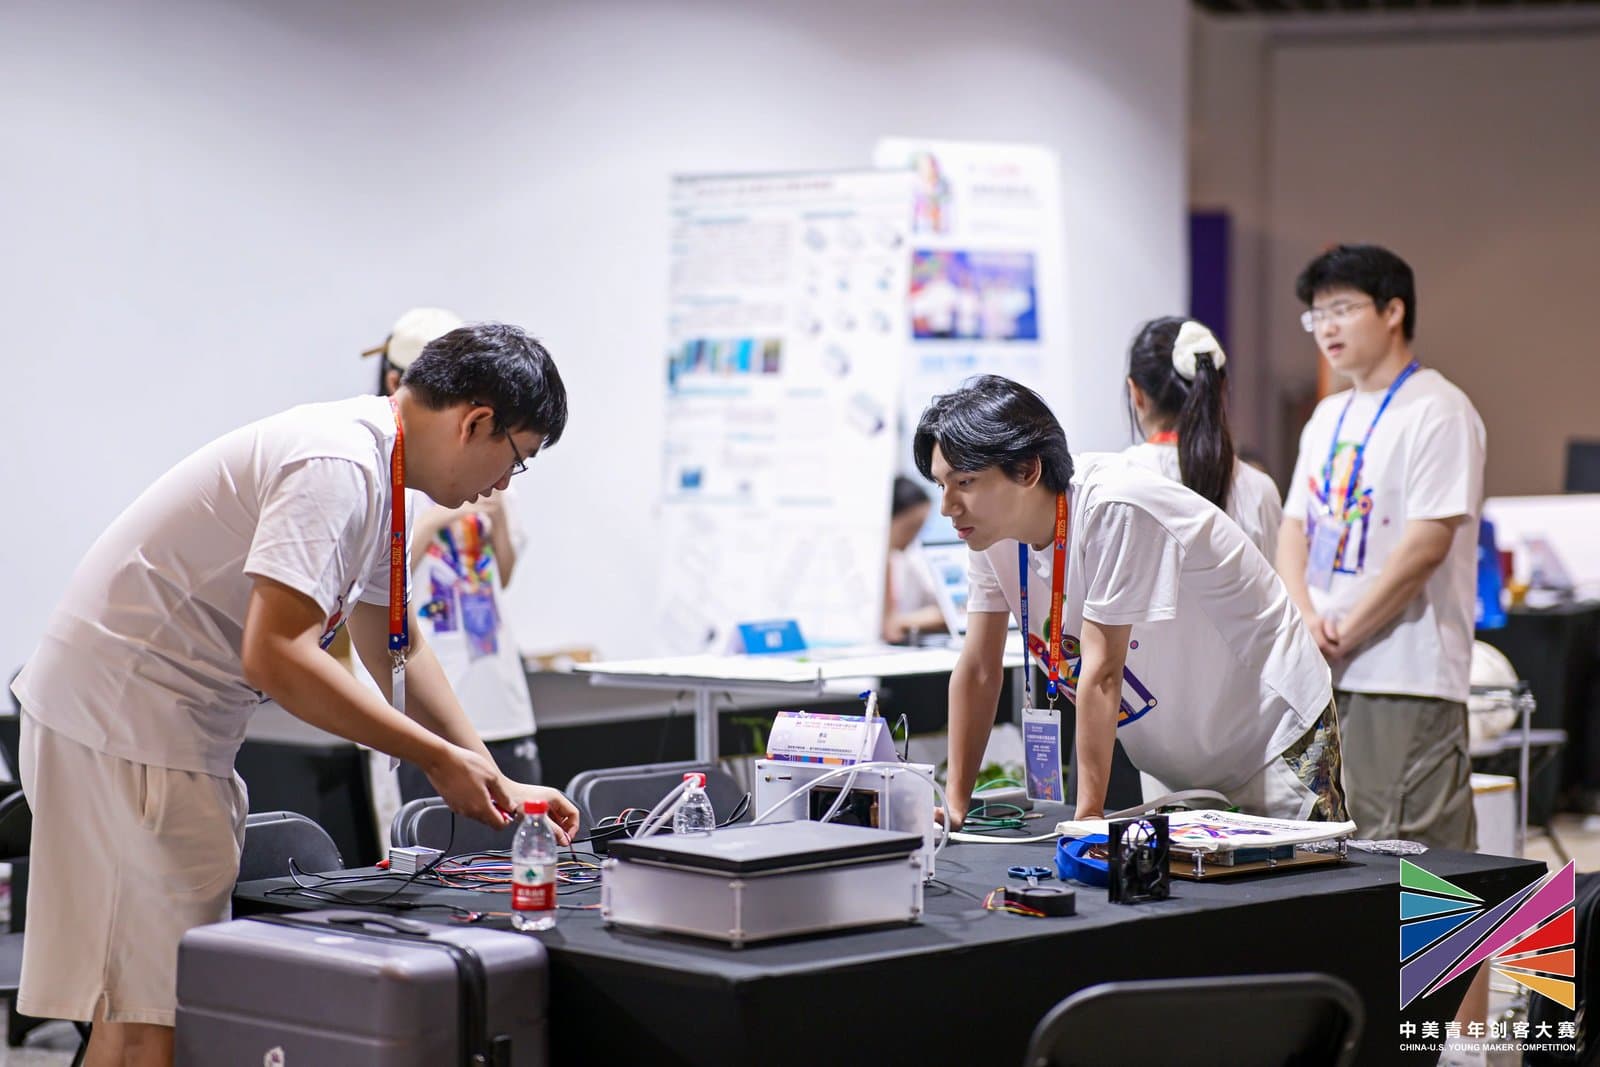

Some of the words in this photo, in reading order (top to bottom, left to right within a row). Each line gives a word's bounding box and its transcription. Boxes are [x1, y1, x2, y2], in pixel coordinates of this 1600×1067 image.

[1057, 520, 1066, 537] 2025
[392, 546, 402, 566] 2025
[1051, 643, 1061, 660] 2025
